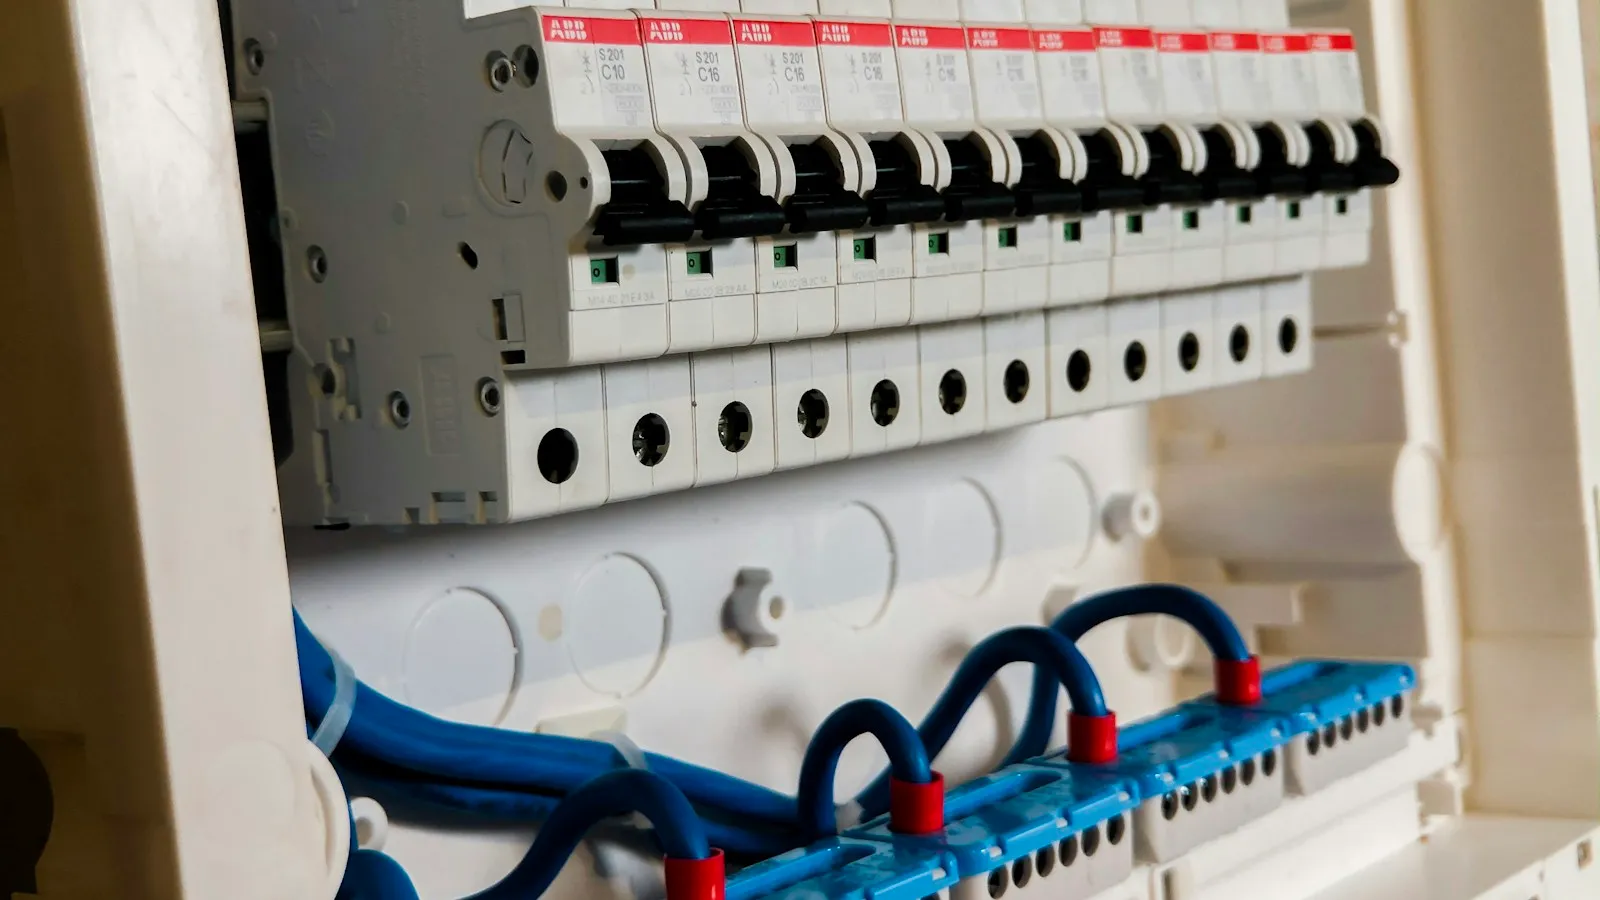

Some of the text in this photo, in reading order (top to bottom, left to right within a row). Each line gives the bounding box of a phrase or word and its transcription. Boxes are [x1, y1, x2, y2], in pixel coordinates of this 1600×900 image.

[551, 19, 588, 41] ABB
[650, 21, 684, 42] ABB
[741, 22, 772, 42] ABB
[822, 24, 850, 43] ABB
[901, 28, 928, 46] ABB
[601, 64, 625, 80] C10
[698, 67, 720, 82] C16
[785, 67, 804, 82] C16
[864, 67, 883, 81] C16
